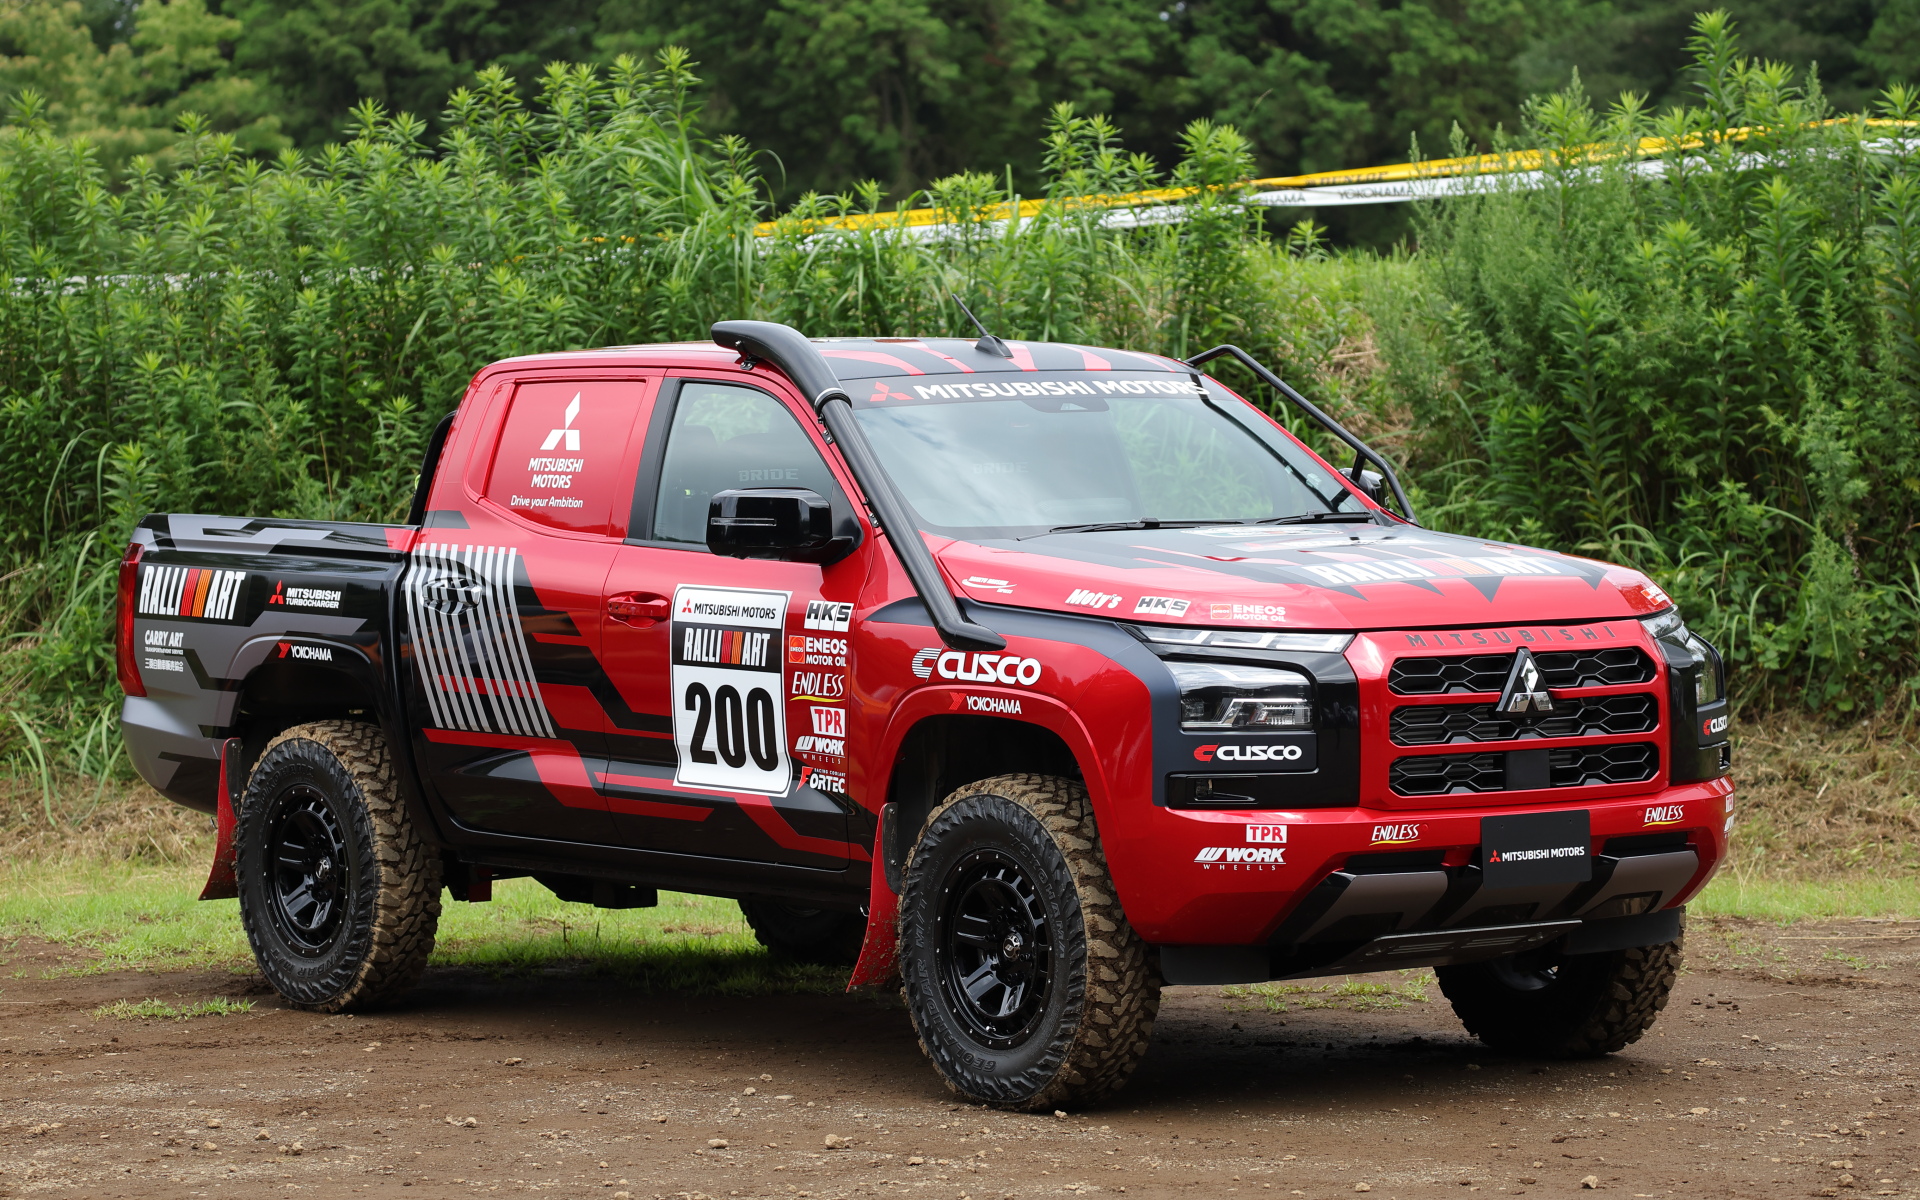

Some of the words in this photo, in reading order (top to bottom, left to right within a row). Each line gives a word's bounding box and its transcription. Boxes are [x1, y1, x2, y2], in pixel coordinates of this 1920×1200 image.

[912, 381, 1096, 399] MITSUBISHI
[1092, 380, 1210, 396] MOTORS
[527, 458, 584, 473] MITSUBISHI
[531, 474, 572, 488] MOTORS
[739, 468, 799, 481] BRIDE
[510, 495, 531, 507] Drive
[530, 497, 549, 509] your
[549, 496, 584, 508] Ambition
[286, 587, 341, 601] MITSUBISHI
[1064, 589, 1123, 609] Moty's
[285, 598, 339, 609] TURBOCHARGER
[694, 603, 741, 617] MITSUBISHI
[741, 606, 776, 620] MOTORS
[806, 602, 850, 622] HKS
[1138, 598, 1189, 612] HKS
[1233, 604, 1286, 615] ENEOS
[1233, 613, 1268, 621] MOTOR
[144, 629, 169, 646] CARRY
[168, 631, 184, 648] ART
[1405, 625, 1616, 647] MITSUBISHI
[290, 645, 333, 662] YOKOHAMA
[805, 637, 847, 655] ENEOS
[805, 654, 833, 666] MOTOR
[834, 656, 847, 667] OIL
[937, 651, 1042, 686] CUSCO
[791, 671, 845, 697] ENDLESS
[966, 695, 1022, 715] YOKOHAMA
[685, 681, 779, 771] 200
[814, 708, 843, 735] TPR
[815, 737, 846, 756] WORK
[1216, 745, 1303, 761] CUSCO
[802, 754, 841, 765] WHEELS
[1643, 804, 1685, 823] ENDLESS
[1250, 825, 1283, 842] TPR
[1371, 824, 1420, 841] ENDLESS
[1226, 847, 1287, 863] WORK
[1501, 849, 1550, 863] MITSUBISHI
[1550, 846, 1585, 858] MOTORS
[915, 891, 928, 949] M/T
[917, 960, 999, 1075] GEOLANDAR
